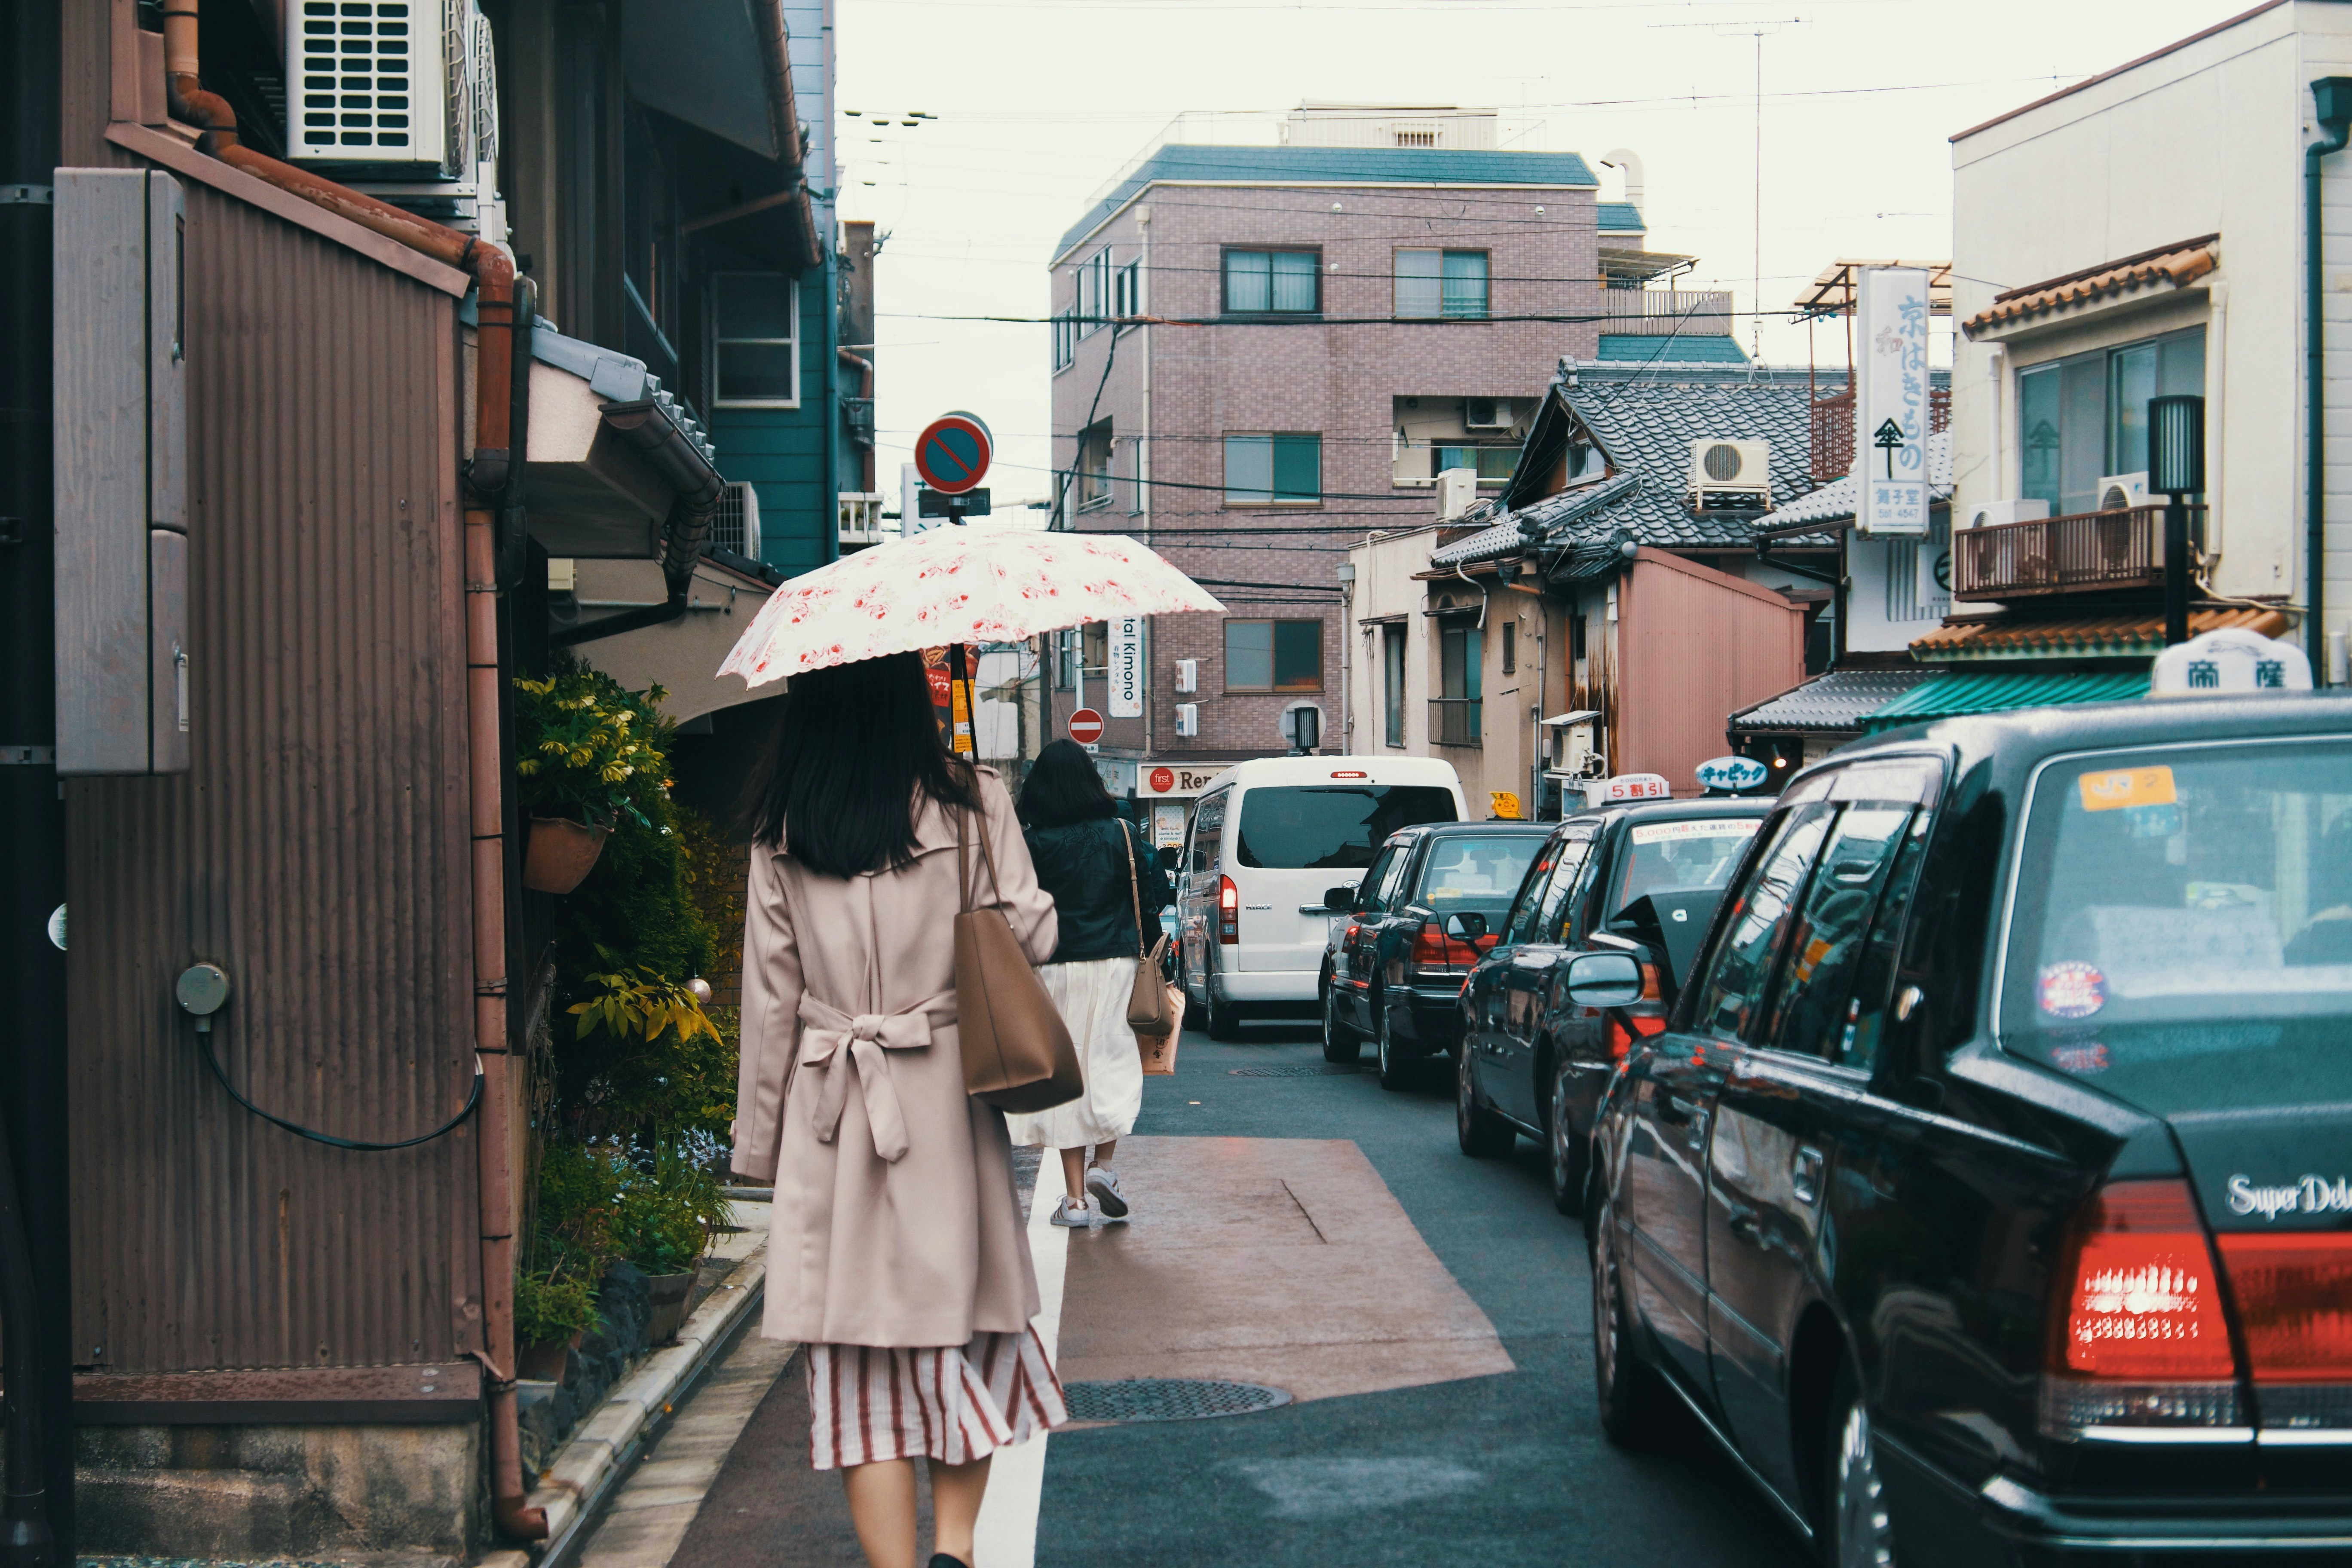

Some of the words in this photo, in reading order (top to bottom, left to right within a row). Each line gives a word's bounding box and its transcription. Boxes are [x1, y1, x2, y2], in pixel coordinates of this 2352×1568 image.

[1899, 295, 1925, 470] 京はきもの
[1124, 616, 1136, 637] tal
[1124, 643, 1136, 700] Kimono
[1155, 773, 1170, 783] first
[1612, 782, 1663, 798] 5割引
[2226, 1173, 2300, 1223] Super
